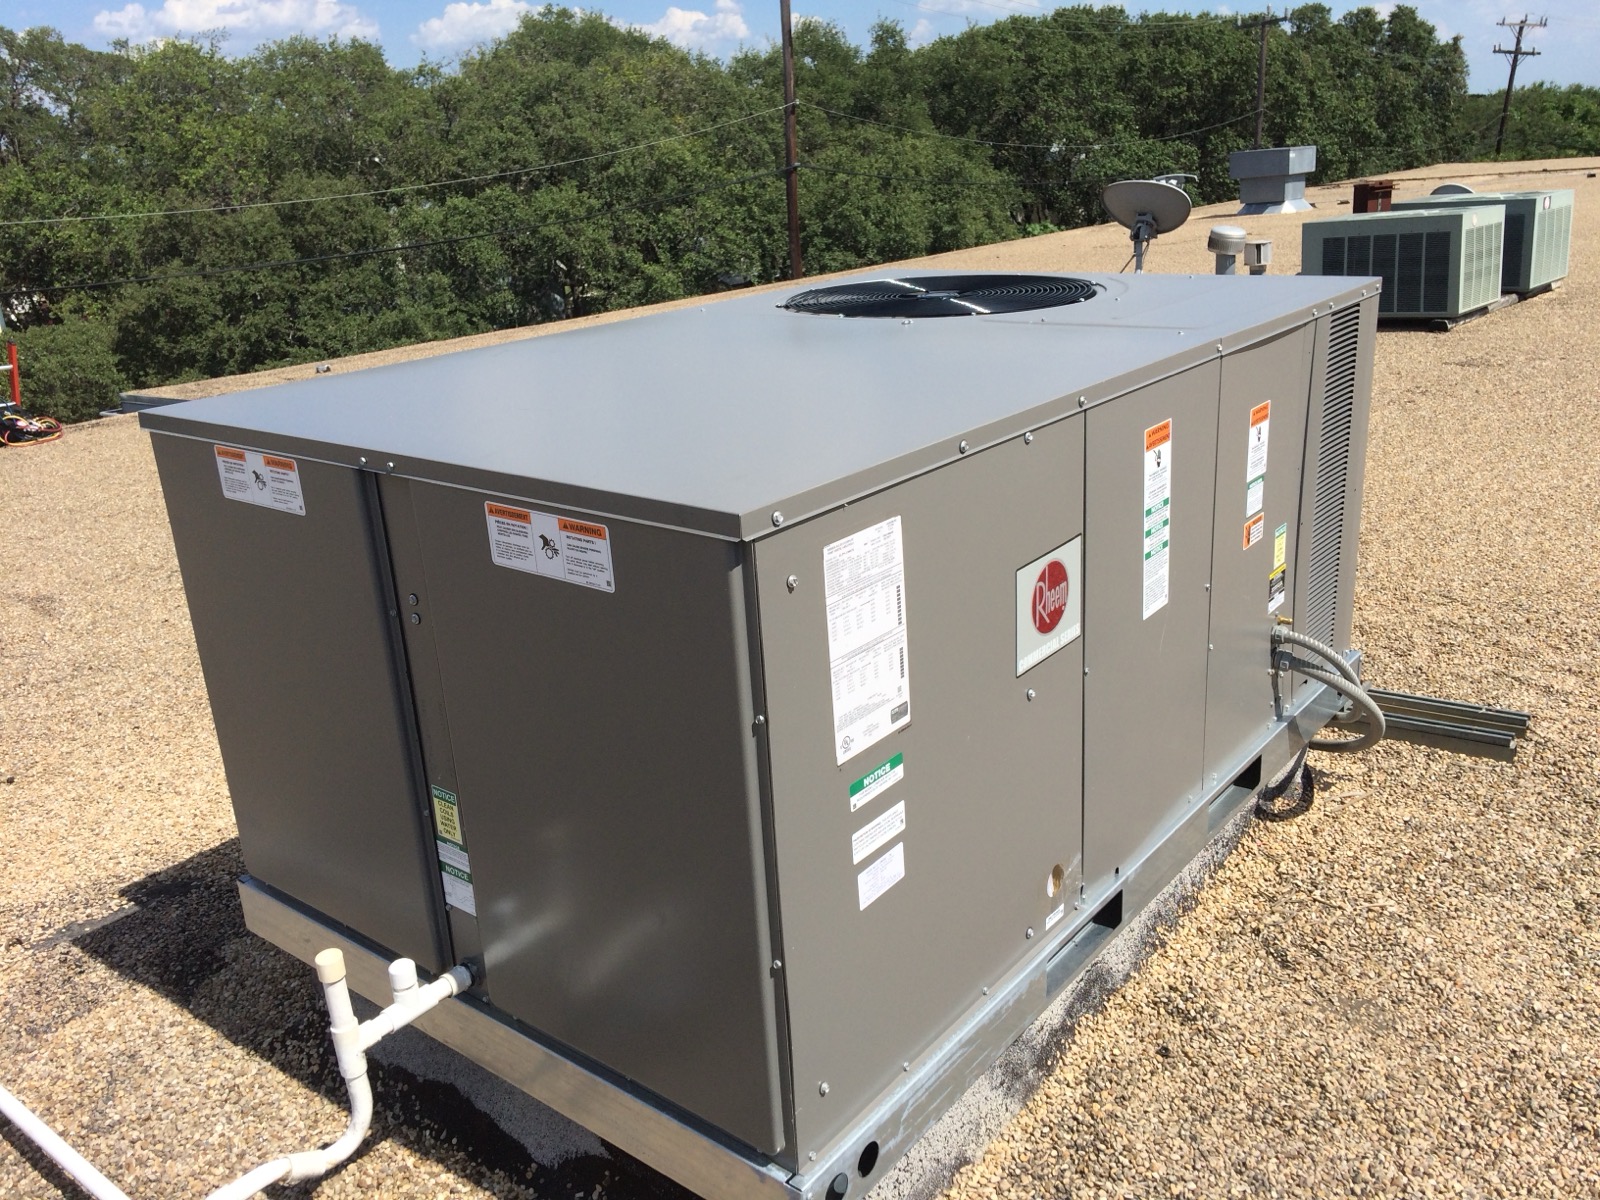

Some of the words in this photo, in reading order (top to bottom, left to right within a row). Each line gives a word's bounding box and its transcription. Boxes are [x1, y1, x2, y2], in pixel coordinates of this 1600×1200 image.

[569, 522, 602, 536] WARNING
[1035, 565, 1067, 628] Rheem
[1018, 636, 1060, 672] COMMERCIAL
[1060, 622, 1080, 646] SERIES
[863, 763, 891, 787] NOTICE
[432, 789, 456, 803] NOTICE
[437, 801, 454, 811] CLEAN
[439, 807, 454, 818] COILS
[440, 815, 456, 825] USING
[440, 820, 457, 831] WATER
[443, 827, 456, 838] ONLY
[445, 864, 469, 880] NOTICE
